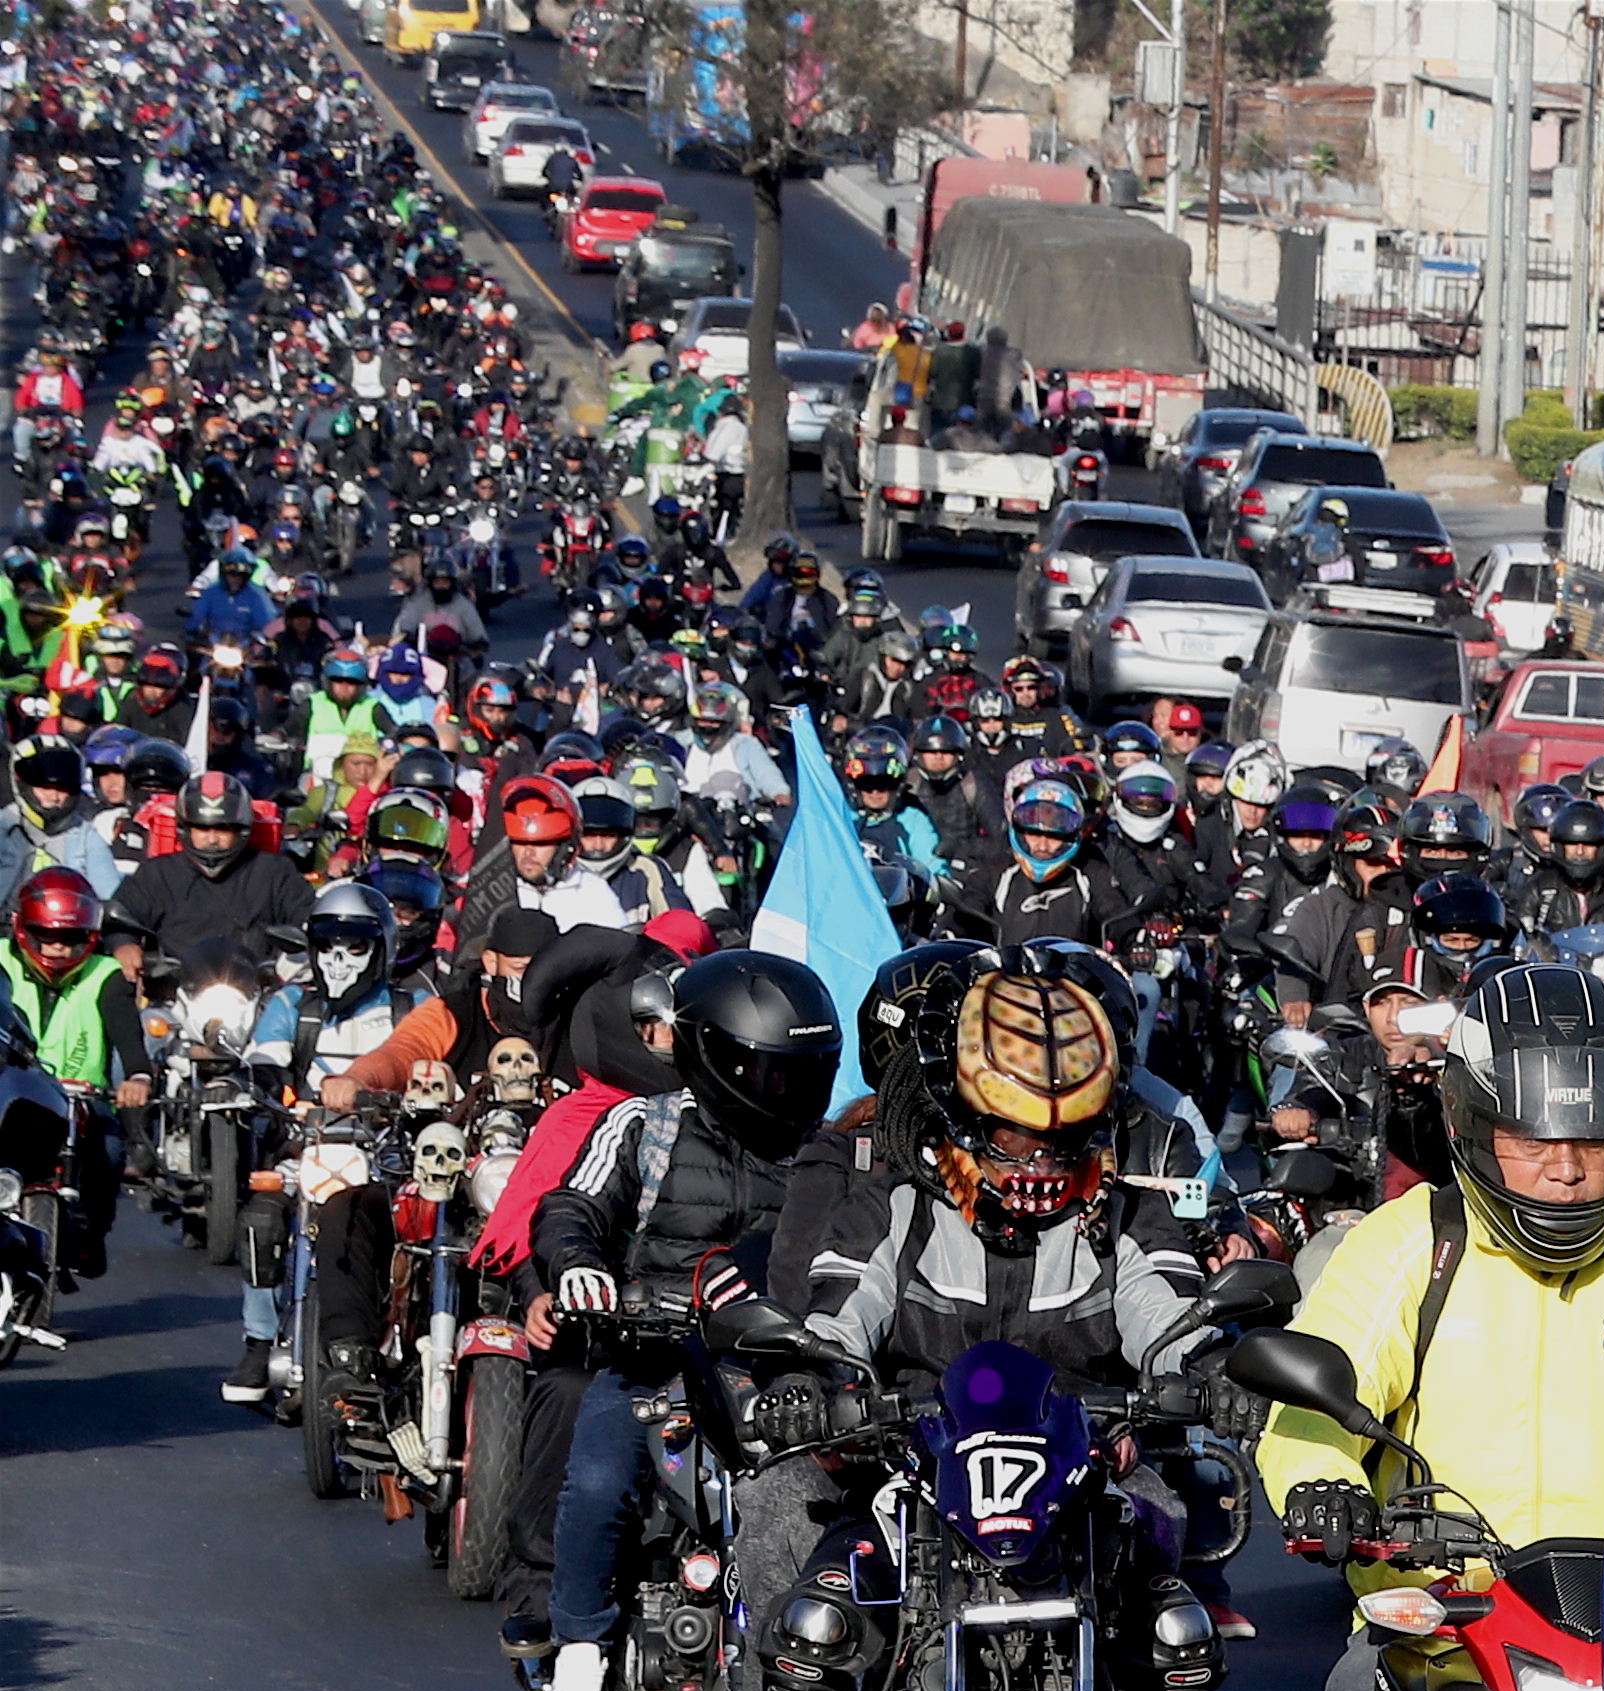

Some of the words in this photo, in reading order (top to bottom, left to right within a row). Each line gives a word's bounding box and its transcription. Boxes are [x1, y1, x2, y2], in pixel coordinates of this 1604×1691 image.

[1545, 1087, 1593, 1102] VIRTUE
[973, 1450, 1042, 1510] 17
[980, 1519, 1031, 1534] MOTUL
